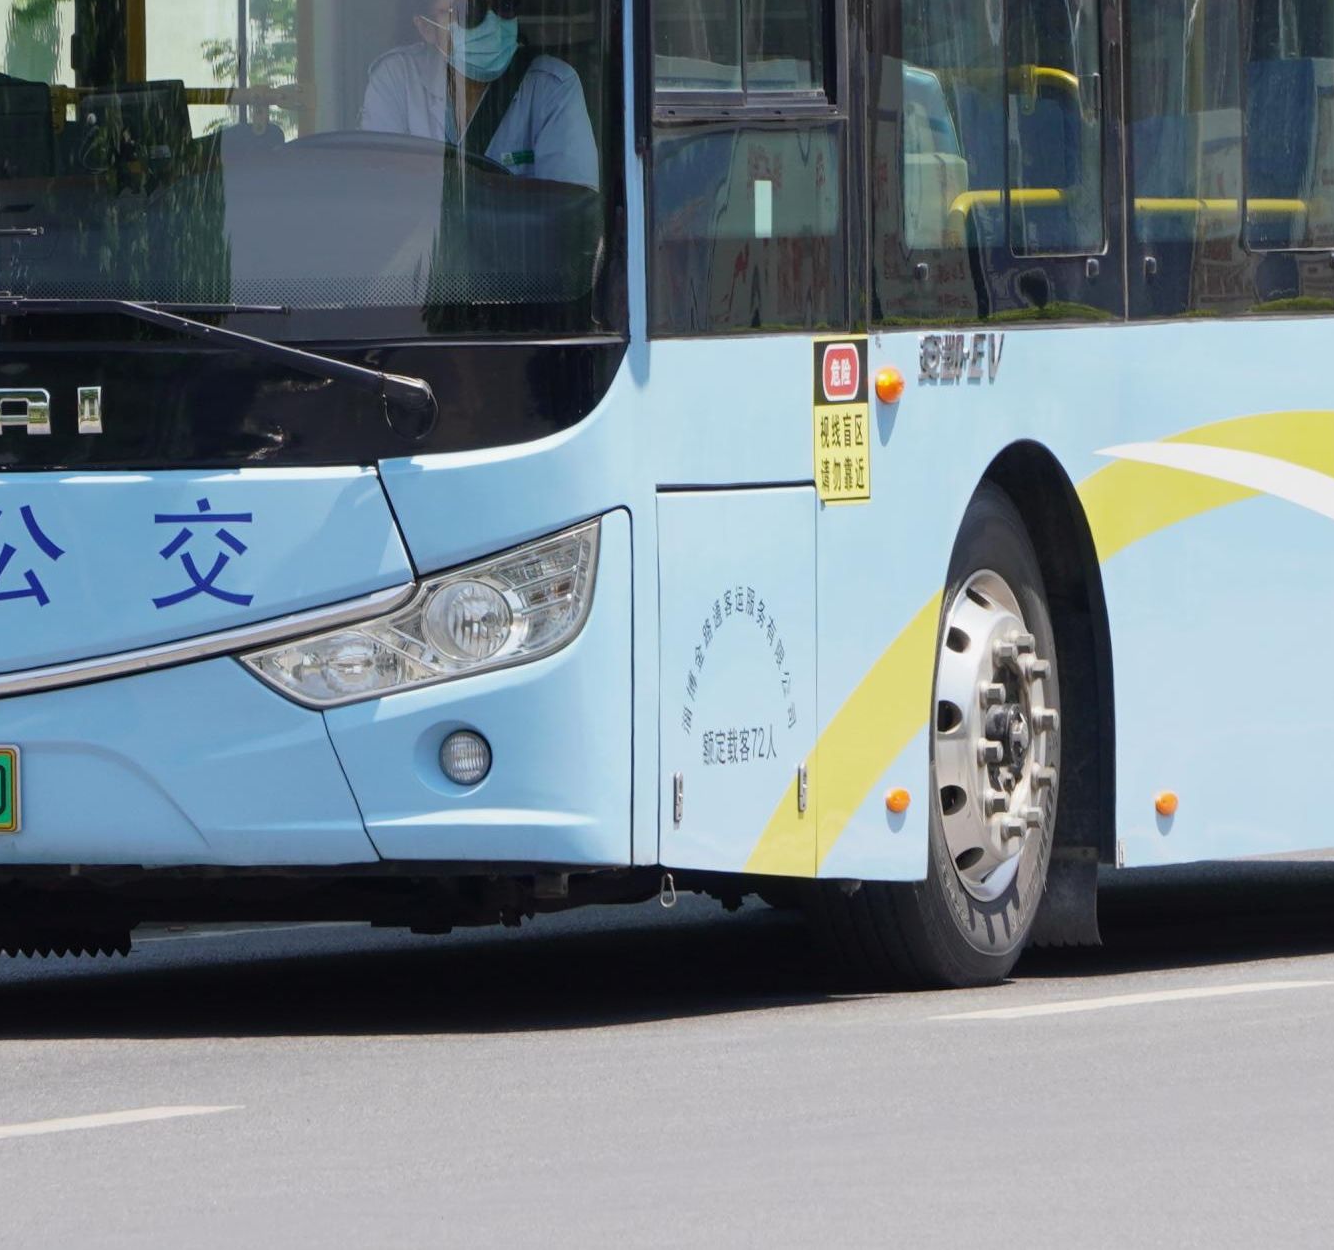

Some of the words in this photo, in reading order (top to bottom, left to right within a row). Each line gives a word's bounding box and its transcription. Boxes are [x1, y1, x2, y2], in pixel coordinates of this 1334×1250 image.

[830, 357, 852, 387] 危险
[820, 412, 864, 449] 视线盲区
[820, 456, 865, 493] 请勿靠近
[702, 722, 778, 766] 额定载客72人
